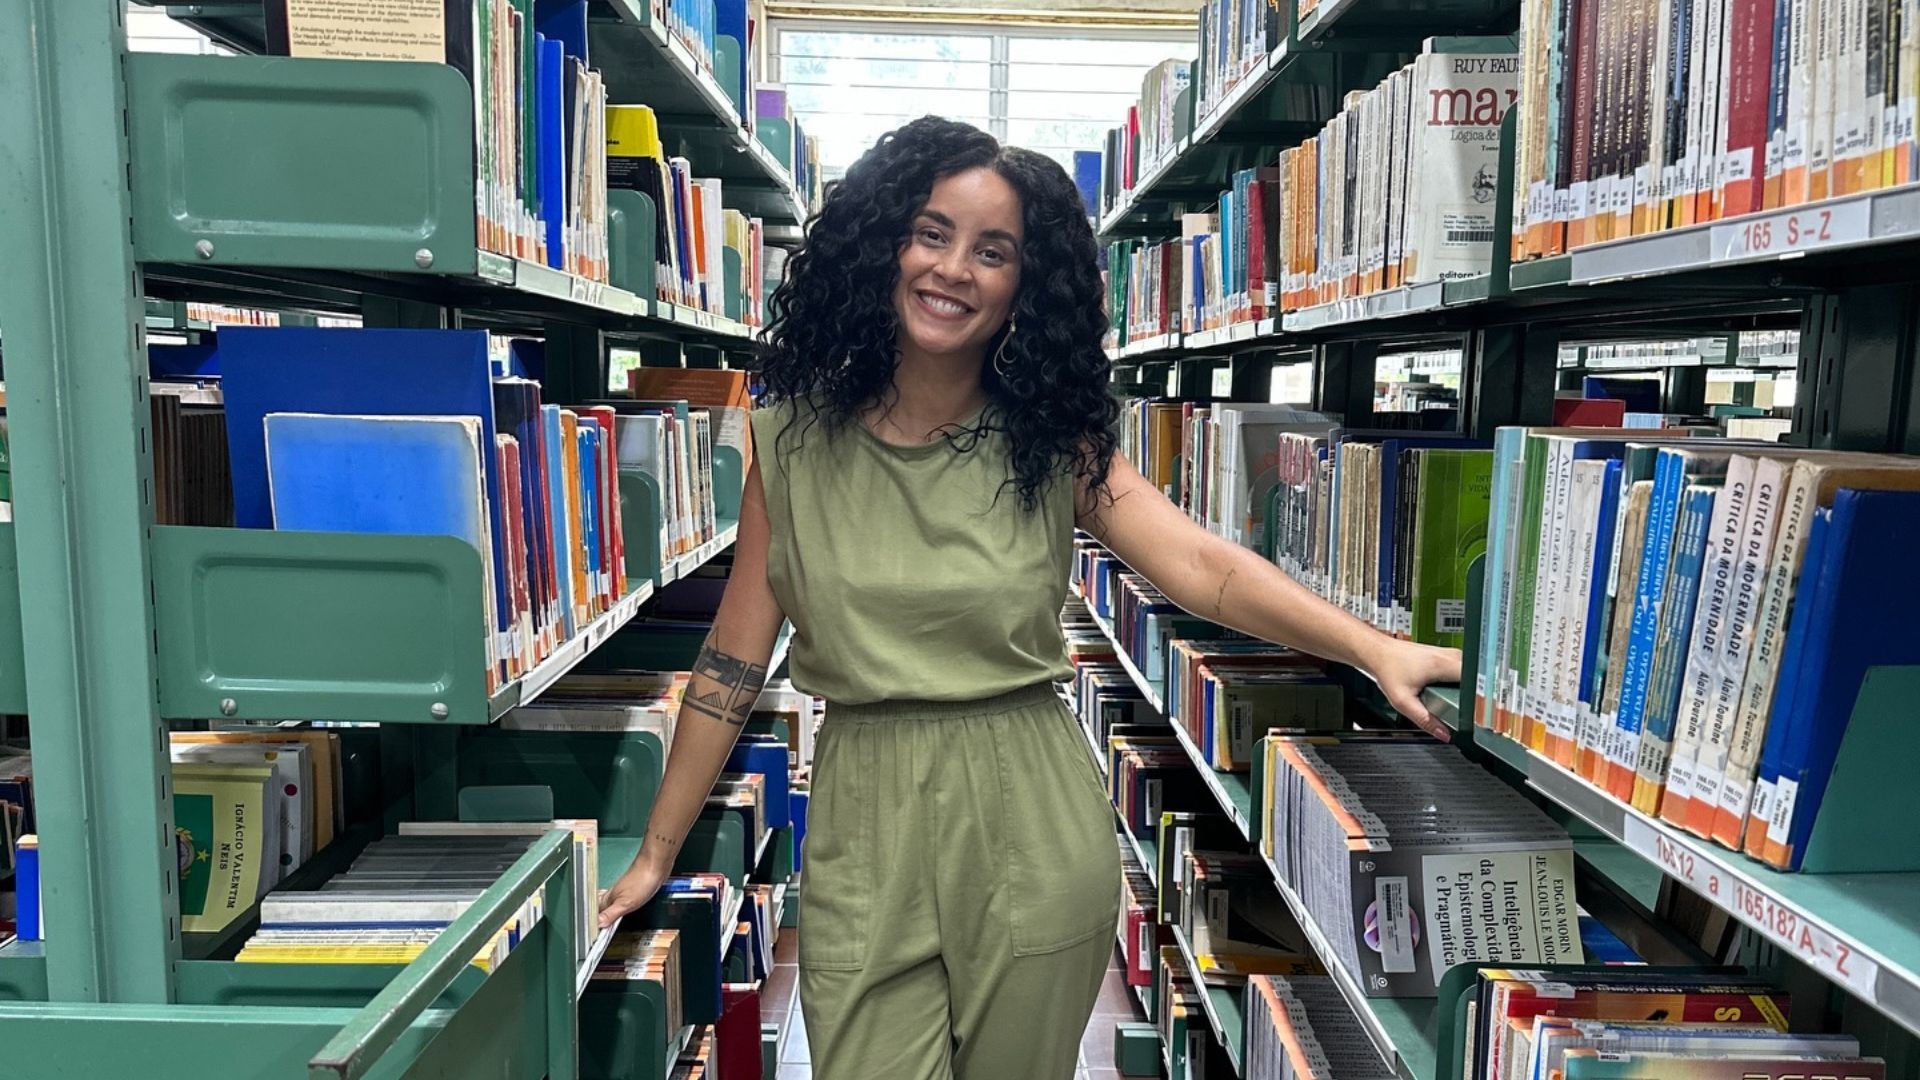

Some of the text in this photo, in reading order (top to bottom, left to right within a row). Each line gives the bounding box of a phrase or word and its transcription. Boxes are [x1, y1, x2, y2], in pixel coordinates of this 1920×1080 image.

[1454, 58, 1487, 73] RUY
[1576, 45, 1589, 117] PRIMEIROS
[1451, 129, 1496, 144] Lógica &
[1743, 221, 1771, 251] 165
[1557, 455, 1570, 506] Adeus
[1551, 527, 1561, 573] razão
[1645, 495, 1660, 555] OBJETIVO
[1659, 500, 1673, 562] OBJETIVO
[1548, 580, 1556, 612] PAUL
[1639, 556, 1652, 596] SABER
[1652, 562, 1665, 600] SABER
[1556, 616, 1567, 658] RAZÃO
[1687, 481, 1745, 739] CRÍTICA DA MODERNIDADE Alain Touraine
[1711, 483, 1772, 745] CRÍTICA DA MODERNIDADE Alain Touraine
[1741, 486, 1805, 754] CRÍTICA DA MODERNIDADE Alain Touraine
[1540, 619, 1552, 691] FEYERABE
[1570, 620, 1582, 664] RAZÃO
[1625, 645, 1638, 688] RAZÃO
[1623, 688, 1633, 705] DA
[1637, 651, 1650, 695] RAZÃO
[1633, 695, 1643, 713] DA
[219, 843, 231, 870] NEIS
[226, 803, 247, 909] IGNÁCIO VALENTIM
[1434, 875, 1456, 967] e Pragmática
[1454, 871, 1483, 962] Epistemologi
[1480, 859, 1501, 964] da Complexida
[1503, 879, 1526, 961] Inteligência
[1535, 855, 1557, 966] JEAN-LOUIS LE MOIG
[1553, 878, 1572, 954] EDGAR MORIN
[1709, 875, 1719, 897] a
[1737, 885, 1797, 942] 165.182
[1800, 925, 1816, 956] A
[1836, 944, 1850, 977] Z
